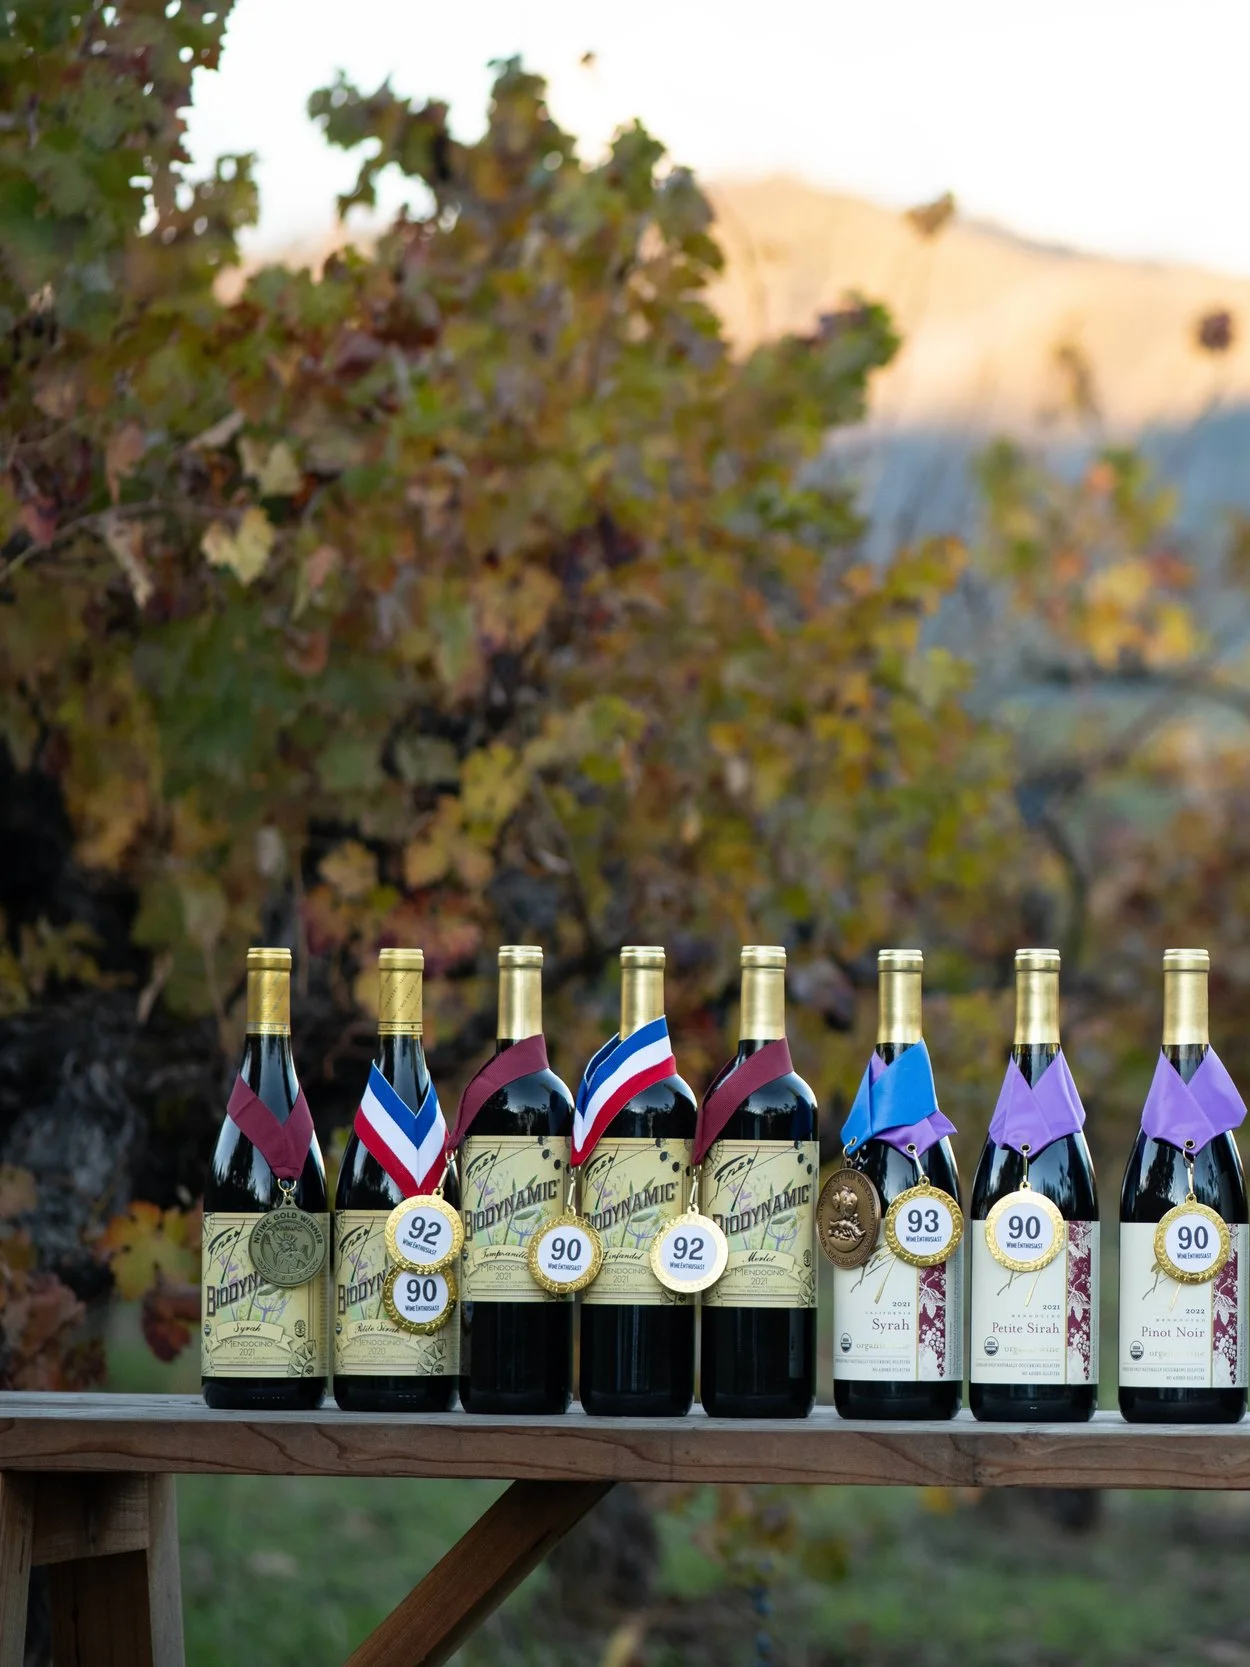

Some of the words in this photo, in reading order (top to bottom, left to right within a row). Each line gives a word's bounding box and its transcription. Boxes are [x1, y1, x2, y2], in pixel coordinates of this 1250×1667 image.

[464, 1179, 558, 1242] BIODYNAMIC
[274, 1212, 298, 1221] GOLD
[300, 1215, 322, 1244] WINNER
[908, 1209, 939, 1233] 93
[1009, 1215, 1041, 1240] 90
[408, 1216, 442, 1246] 92
[1178, 1226, 1209, 1249] 90
[551, 1237, 582, 1261] 90
[673, 1236, 704, 1260] 92
[742, 1251, 776, 1263] Merlot
[495, 1272, 512, 1281] 2021
[613, 1275, 629, 1283] 2021
[734, 1267, 785, 1276] MENDOCINO
[406, 1279, 437, 1302] 90
[751, 1277, 768, 1286] 2021
[207, 1271, 266, 1317] BIODYN
[338, 1270, 387, 1316] BIODYN
[233, 1322, 262, 1334] Syrah
[872, 1318, 910, 1334] Syrah
[992, 1322, 1023, 1333] Petite
[1027, 1322, 1060, 1334] Sirah
[1141, 1326, 1172, 1337] Pinot
[1176, 1327, 1205, 1337] Noir
[225, 1340, 273, 1348] MENDOCINO
[239, 1348, 256, 1356] 2021
